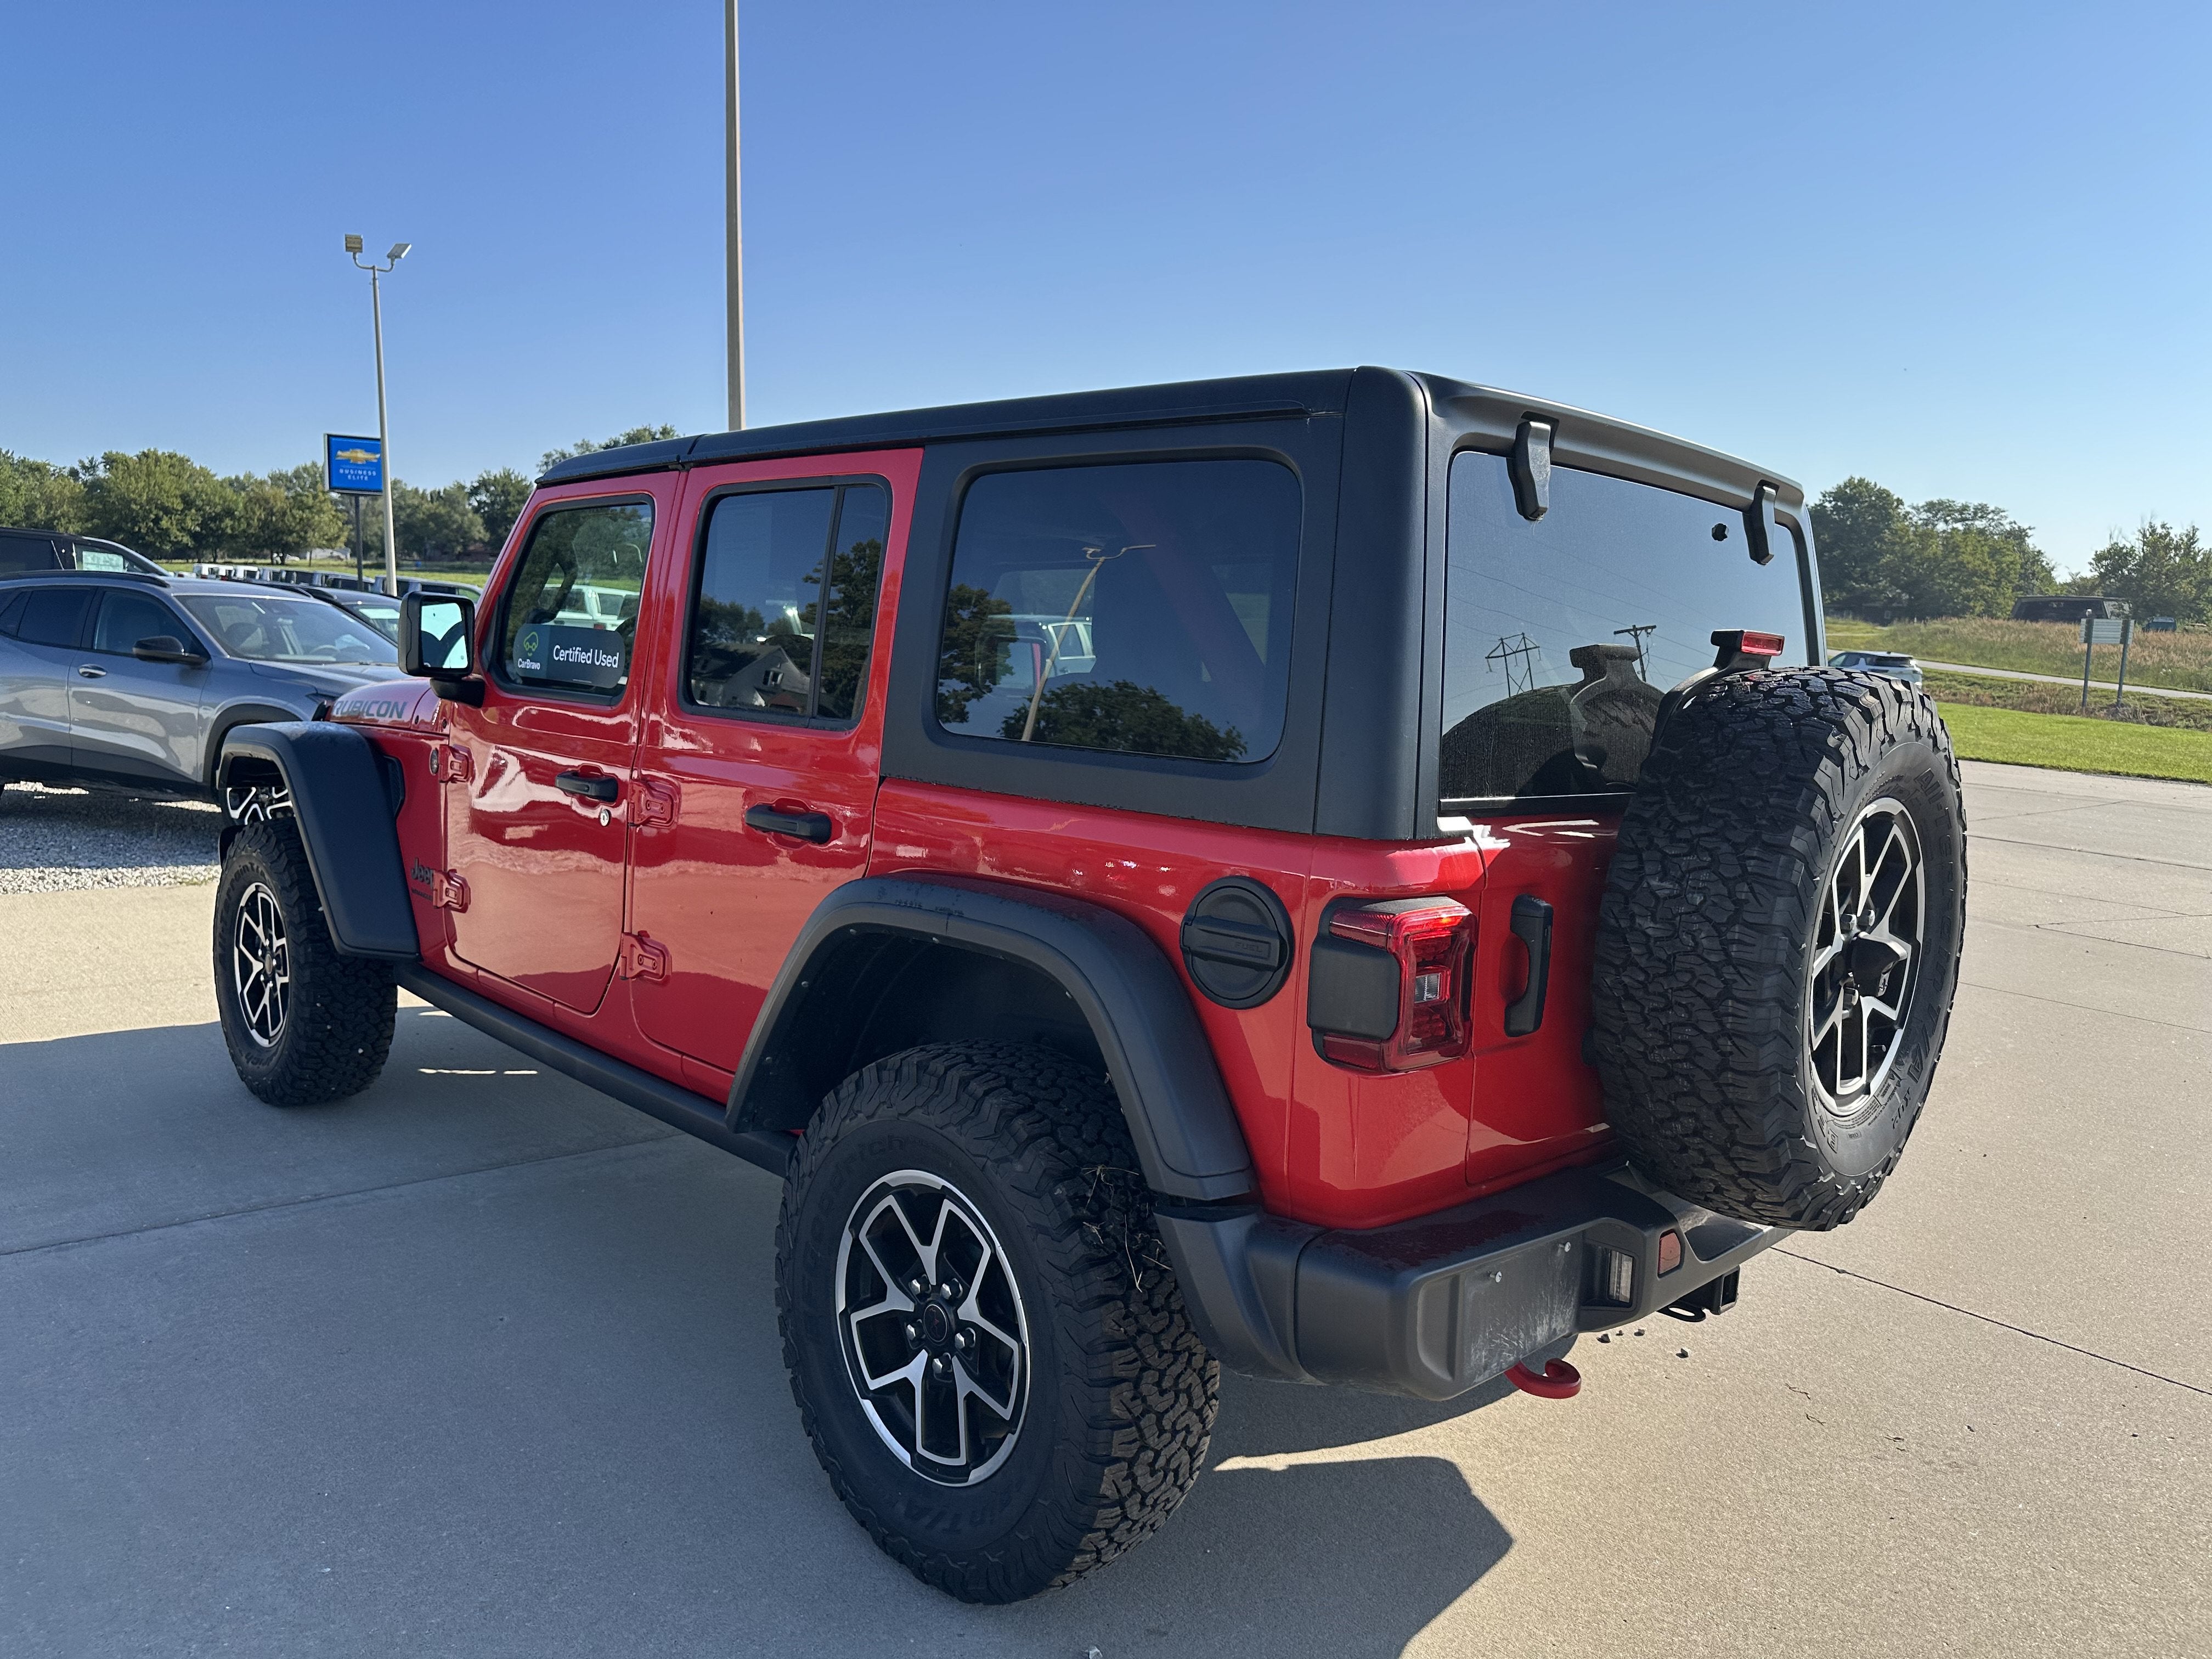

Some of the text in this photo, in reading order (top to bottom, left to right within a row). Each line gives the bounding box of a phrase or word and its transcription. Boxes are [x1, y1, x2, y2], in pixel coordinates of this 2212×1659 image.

[339, 468, 376, 476] BUSINESS
[553, 645, 619, 668] Certified Used
[517, 658, 540, 670] CarBravo
[335, 700, 408, 719] RUBICON
[1234, 941, 1262, 953] FUEL
